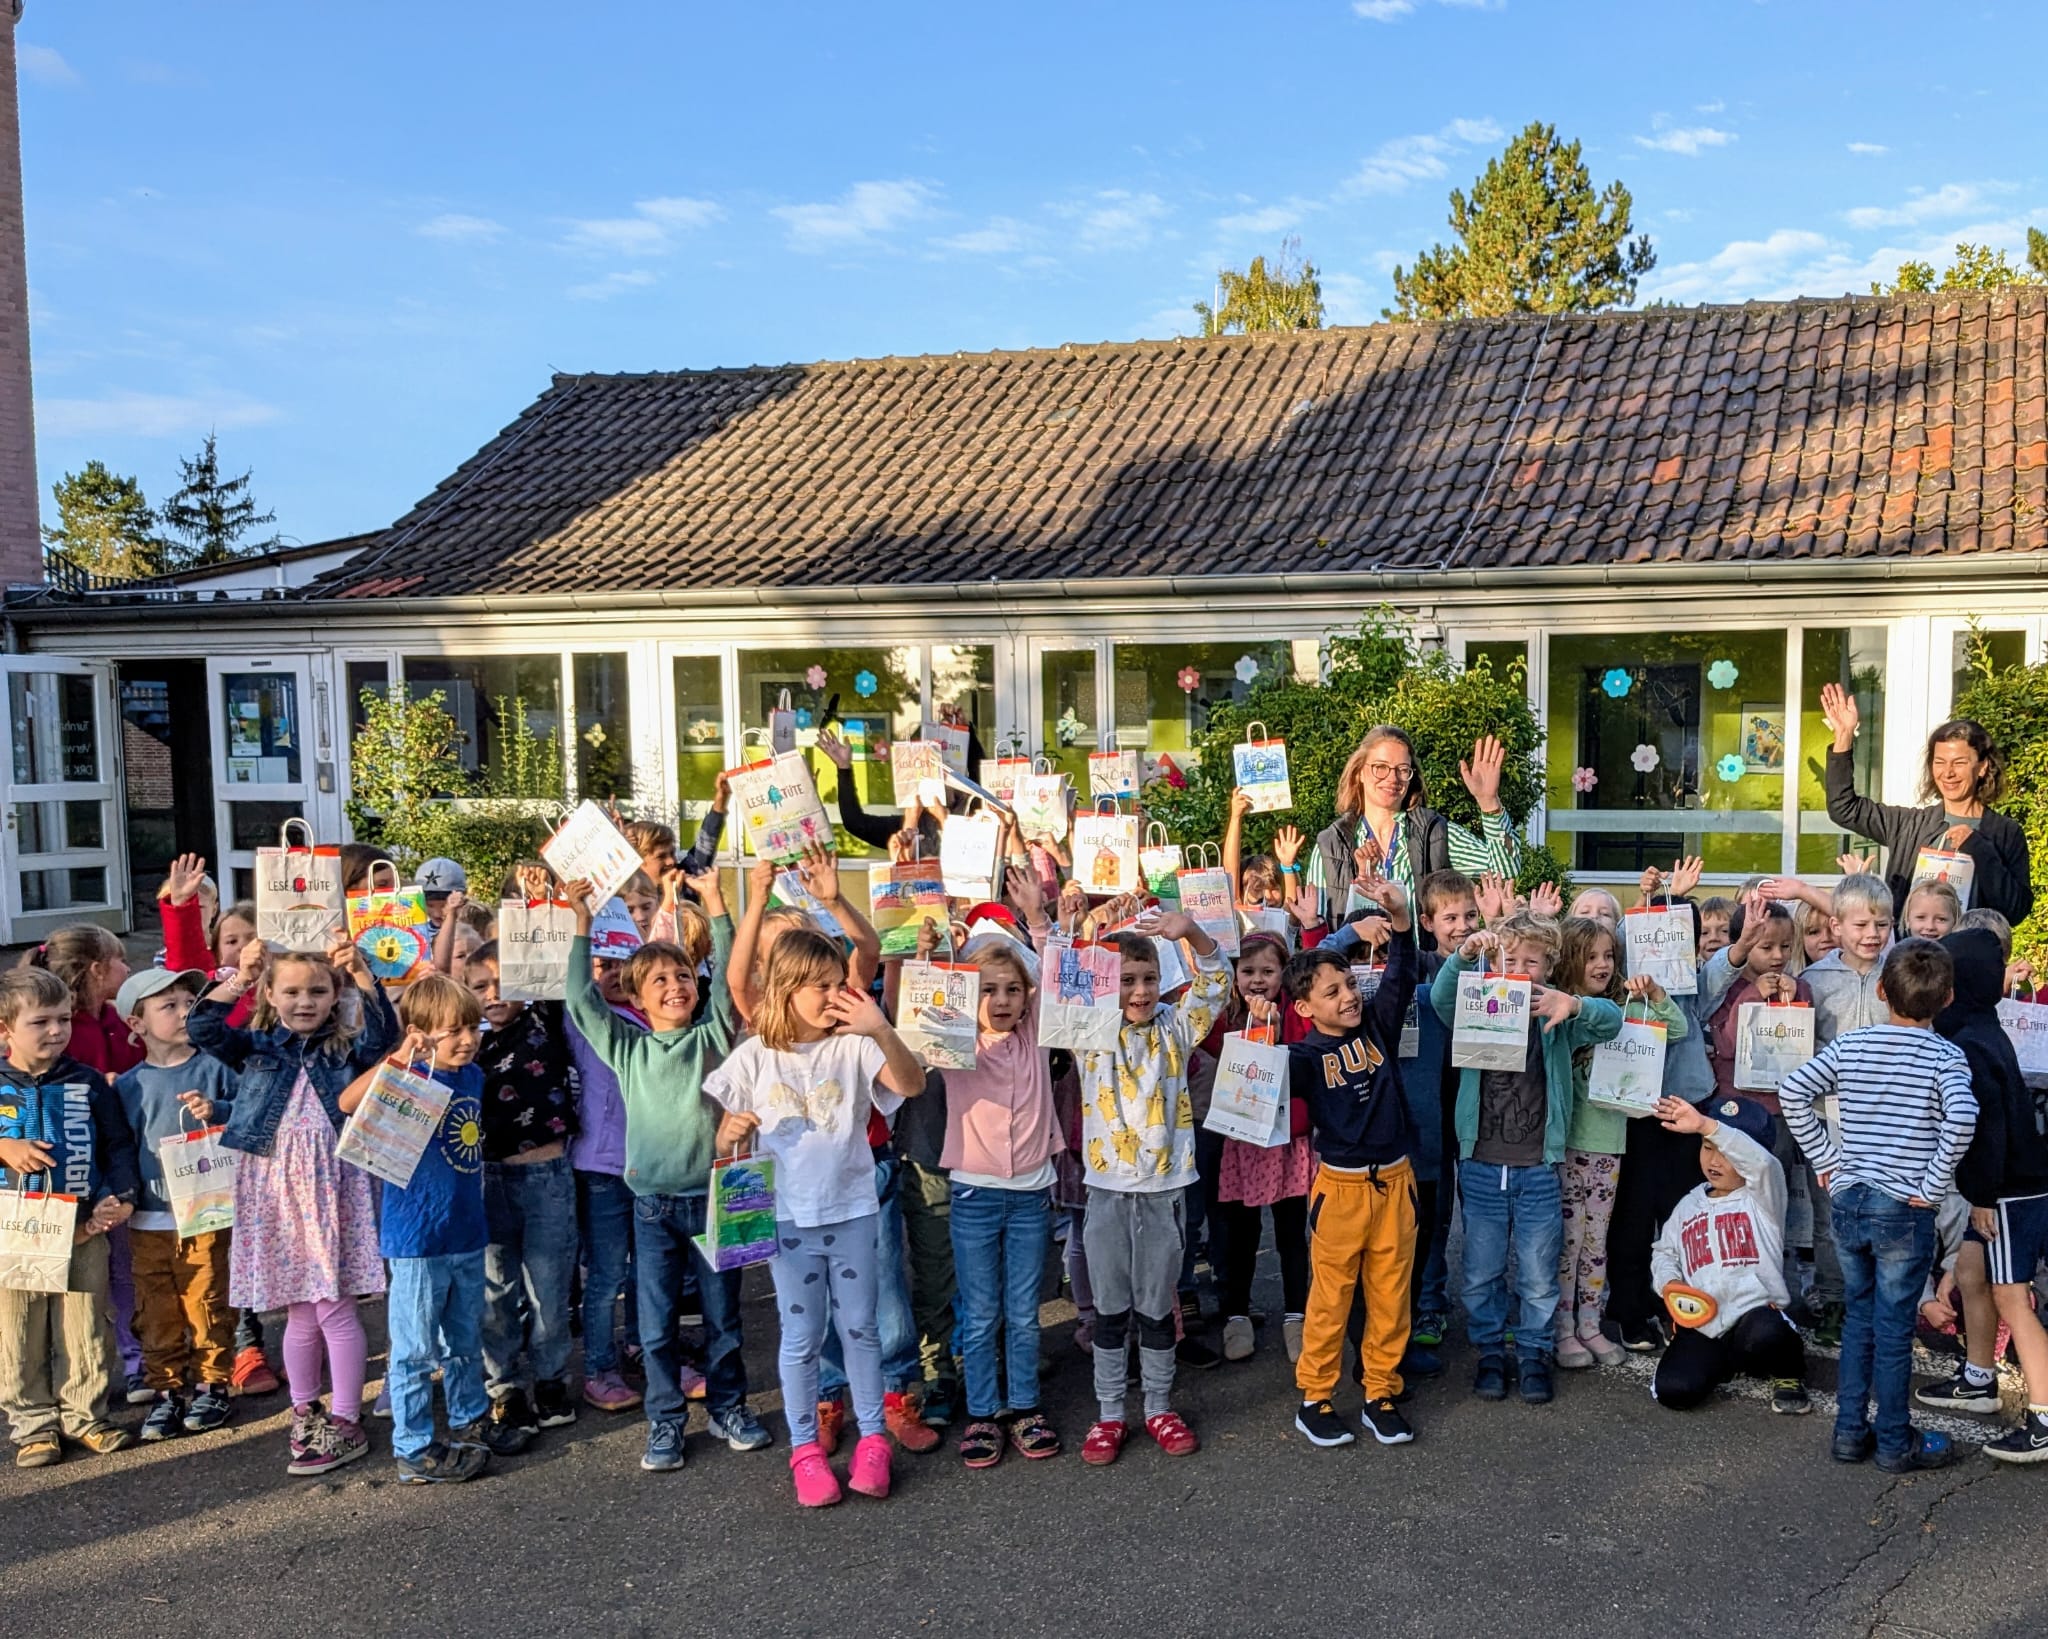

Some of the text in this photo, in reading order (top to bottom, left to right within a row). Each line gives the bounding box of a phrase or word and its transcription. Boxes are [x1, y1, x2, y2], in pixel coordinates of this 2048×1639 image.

[746, 783, 804, 809] LESE TÜTE
[1083, 836, 1099, 846] LESE
[268, 879, 331, 892] LESE TÜTE
[509, 931, 568, 943] LESE TÜTE
[1634, 931, 1685, 944] LESE TÜTE
[1053, 973, 1109, 987] LESE TÜTE
[910, 992, 930, 1004] LESE
[1465, 1001, 1520, 1014] LESE TÜTE
[1999, 1019, 2015, 1027] ESE
[1756, 1027, 1805, 1038] LESE TÜTE
[1604, 1042, 1656, 1057] LESE TÜTE
[1227, 1062, 1275, 1083] LESE TÜTE
[379, 1091, 432, 1126] LESE TÜTE
[63, 1083, 92, 1200] NINJAGO
[174, 1156, 235, 1177] LESE TÜTE
[1, 1221, 64, 1235] LESE TÜTE
